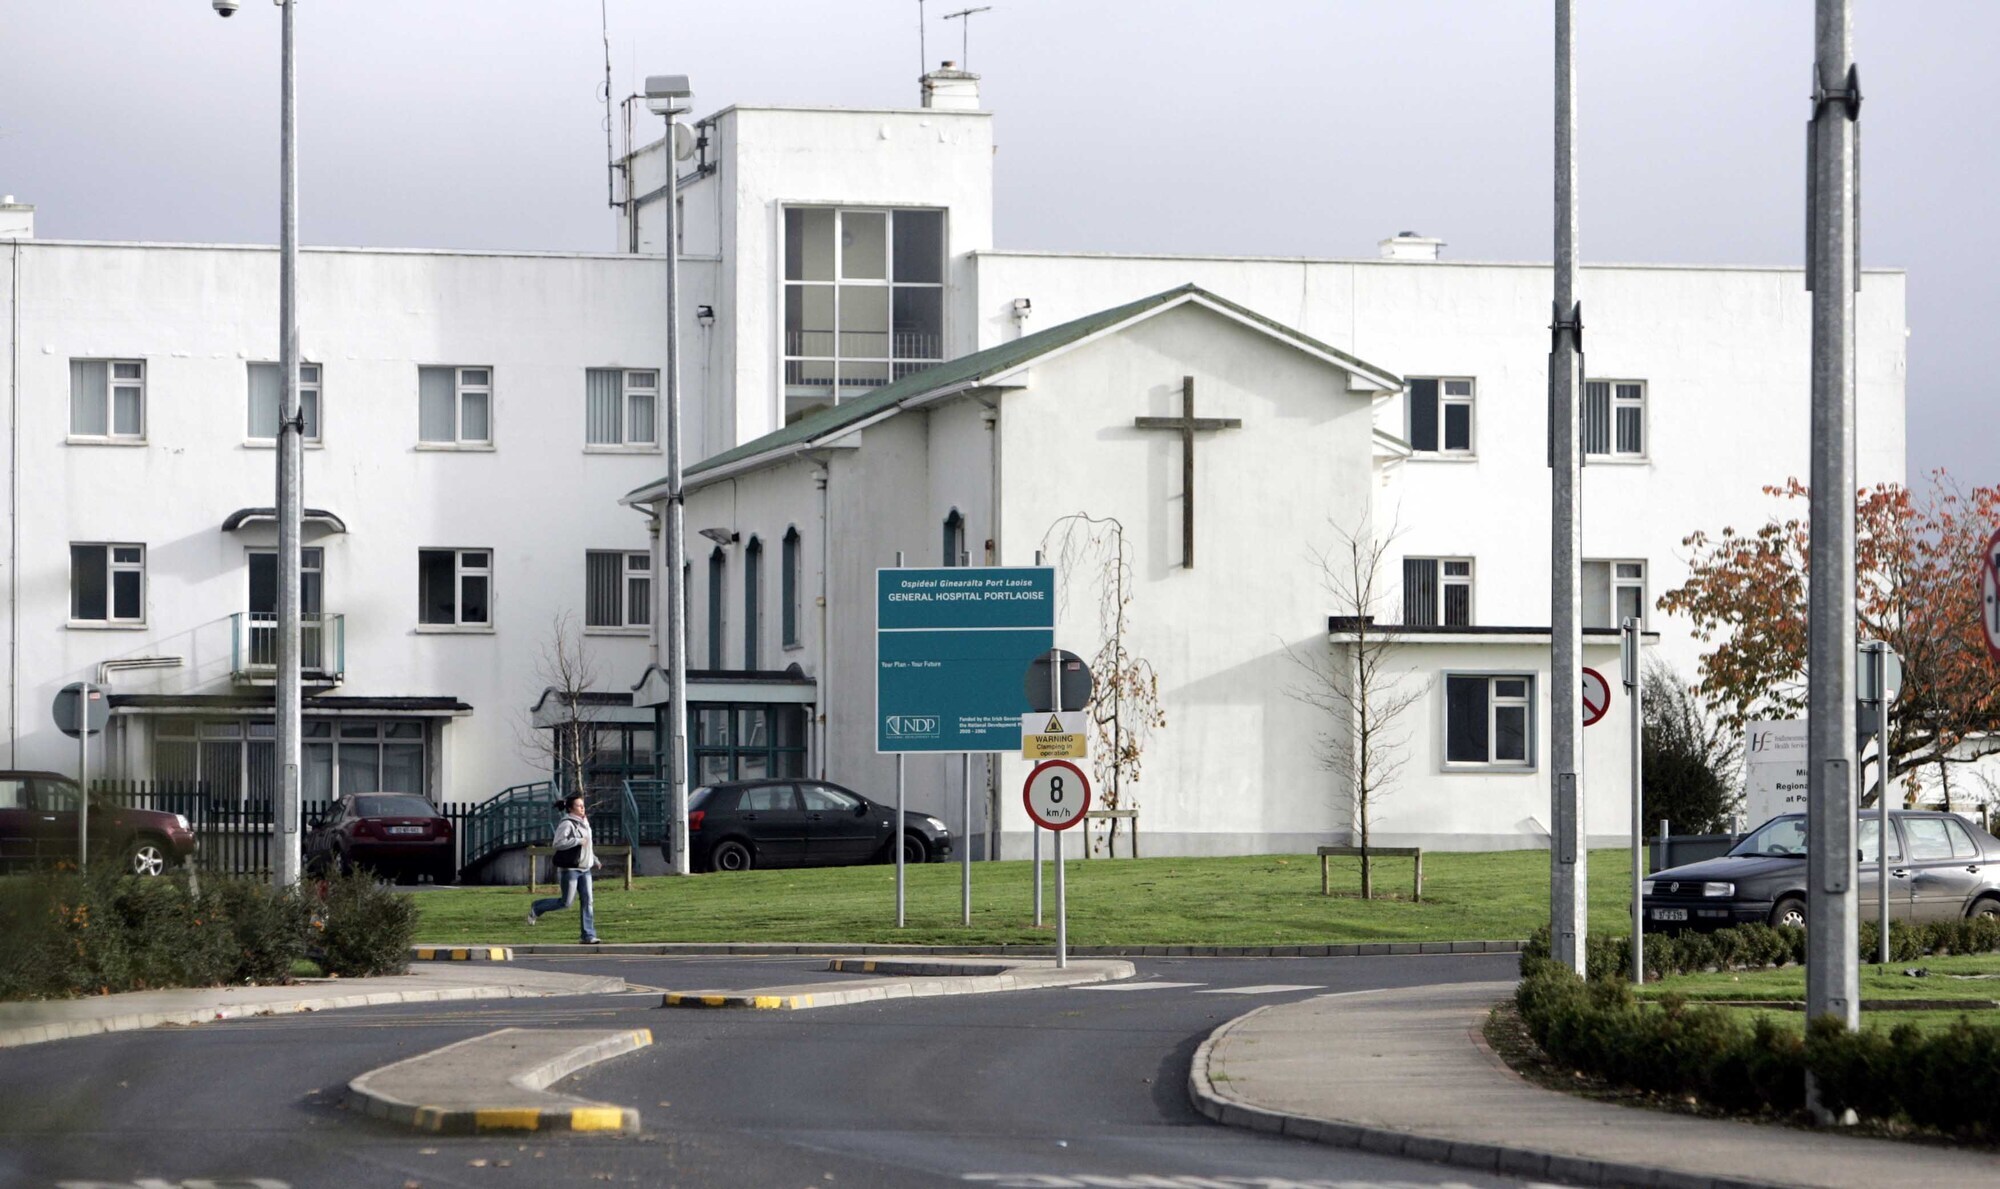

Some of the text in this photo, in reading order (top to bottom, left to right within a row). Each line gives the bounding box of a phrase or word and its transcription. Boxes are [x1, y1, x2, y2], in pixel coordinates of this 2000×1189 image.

[901, 579, 1033, 588] Ospidéal Ginearálta Port Laoise
[888, 591, 1044, 601] GENERAL HOSPITAL PORTLAOISE
[904, 718, 935, 732] NDP
[1050, 775, 1064, 803] 8
[1046, 807, 1071, 818] km/h
